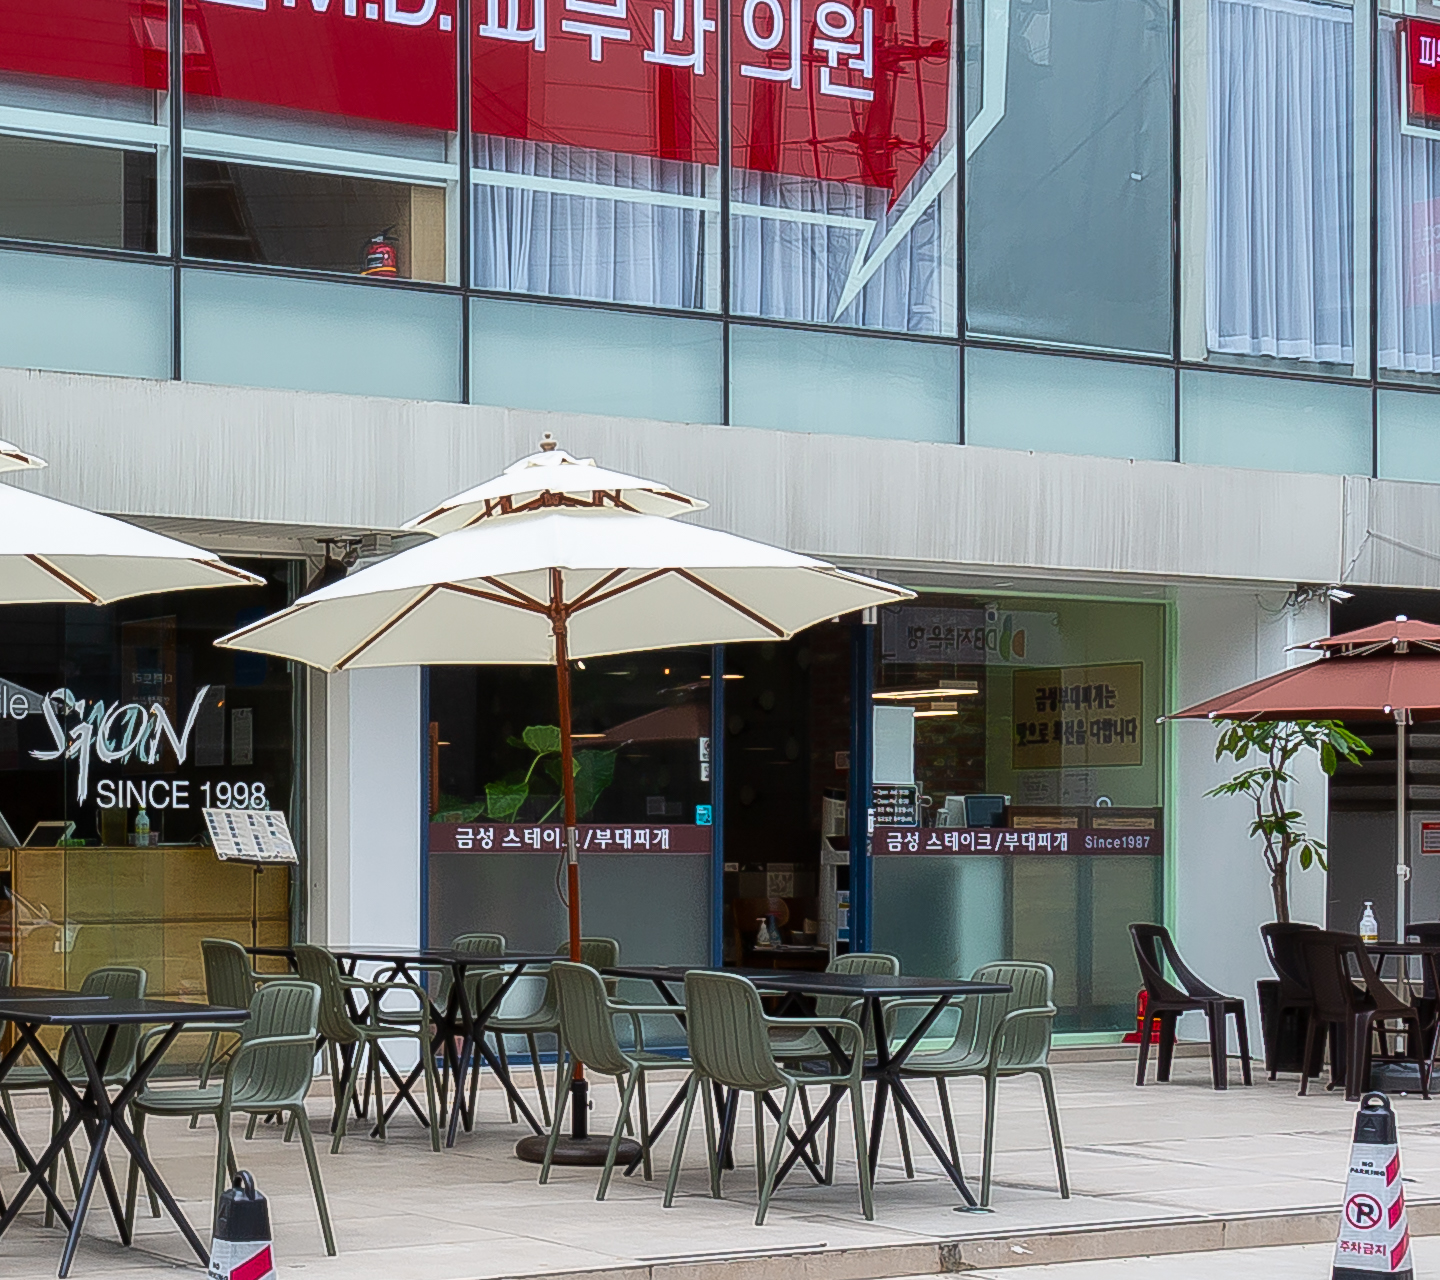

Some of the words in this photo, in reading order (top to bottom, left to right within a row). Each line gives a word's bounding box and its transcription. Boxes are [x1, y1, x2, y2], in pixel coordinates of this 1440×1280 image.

[96, 779, 190, 809] SINCE
[200, 781, 266, 809] 1998
[455, 827, 494, 850] 금성
[886, 832, 919, 852] 금성
[1349, 1167, 1386, 1177] PARKING
[1339, 1240, 1387, 1256] 주차금지
